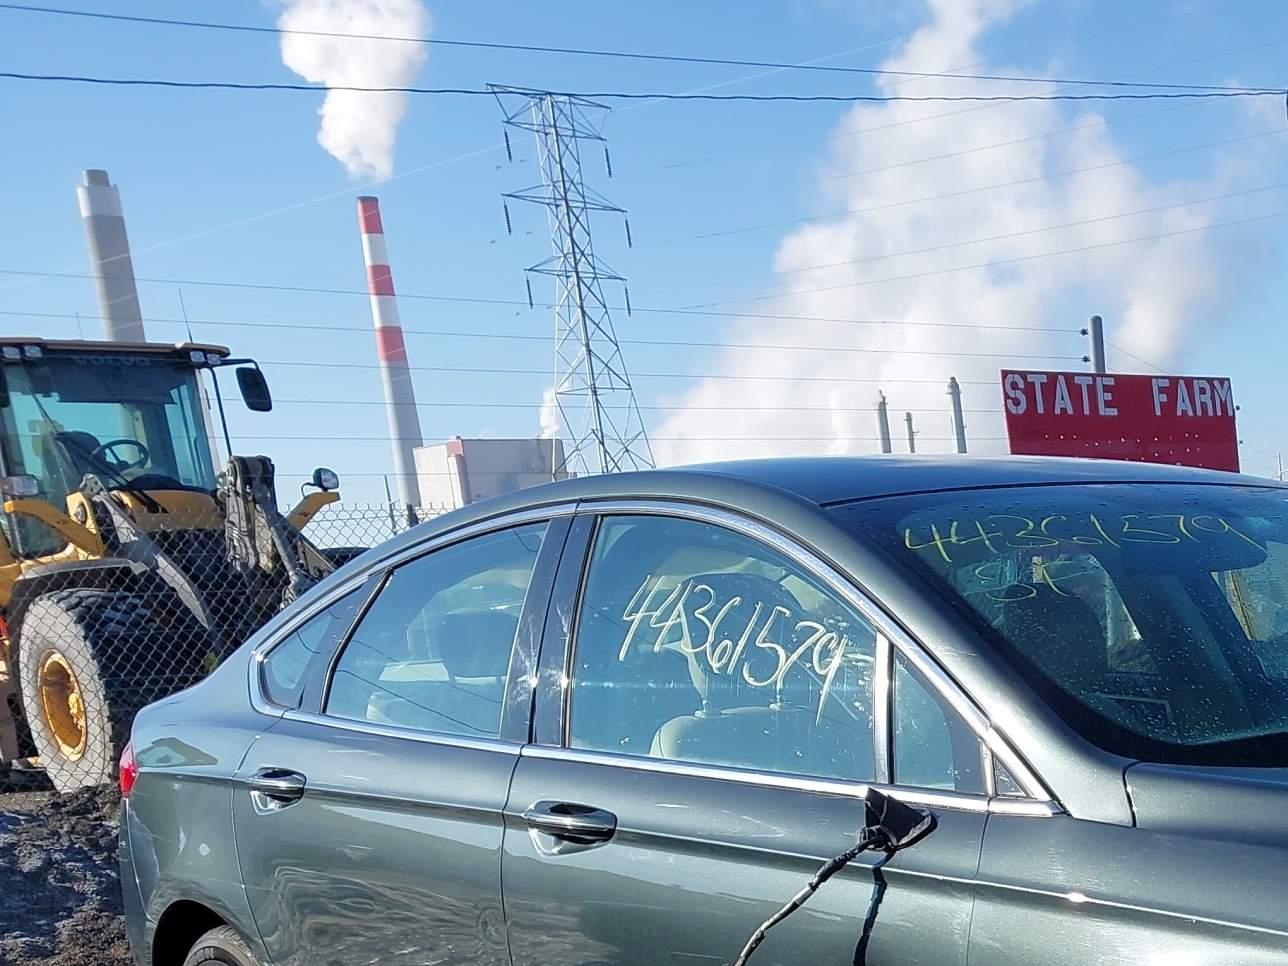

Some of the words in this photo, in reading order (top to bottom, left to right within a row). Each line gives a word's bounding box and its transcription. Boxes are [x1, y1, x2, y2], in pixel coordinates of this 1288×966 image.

[1004, 373, 1119, 417] STATE
[1151, 377, 1234, 417] FARM
[904, 513, 1268, 563] 44361579
[618, 574, 850, 727] 44361579
